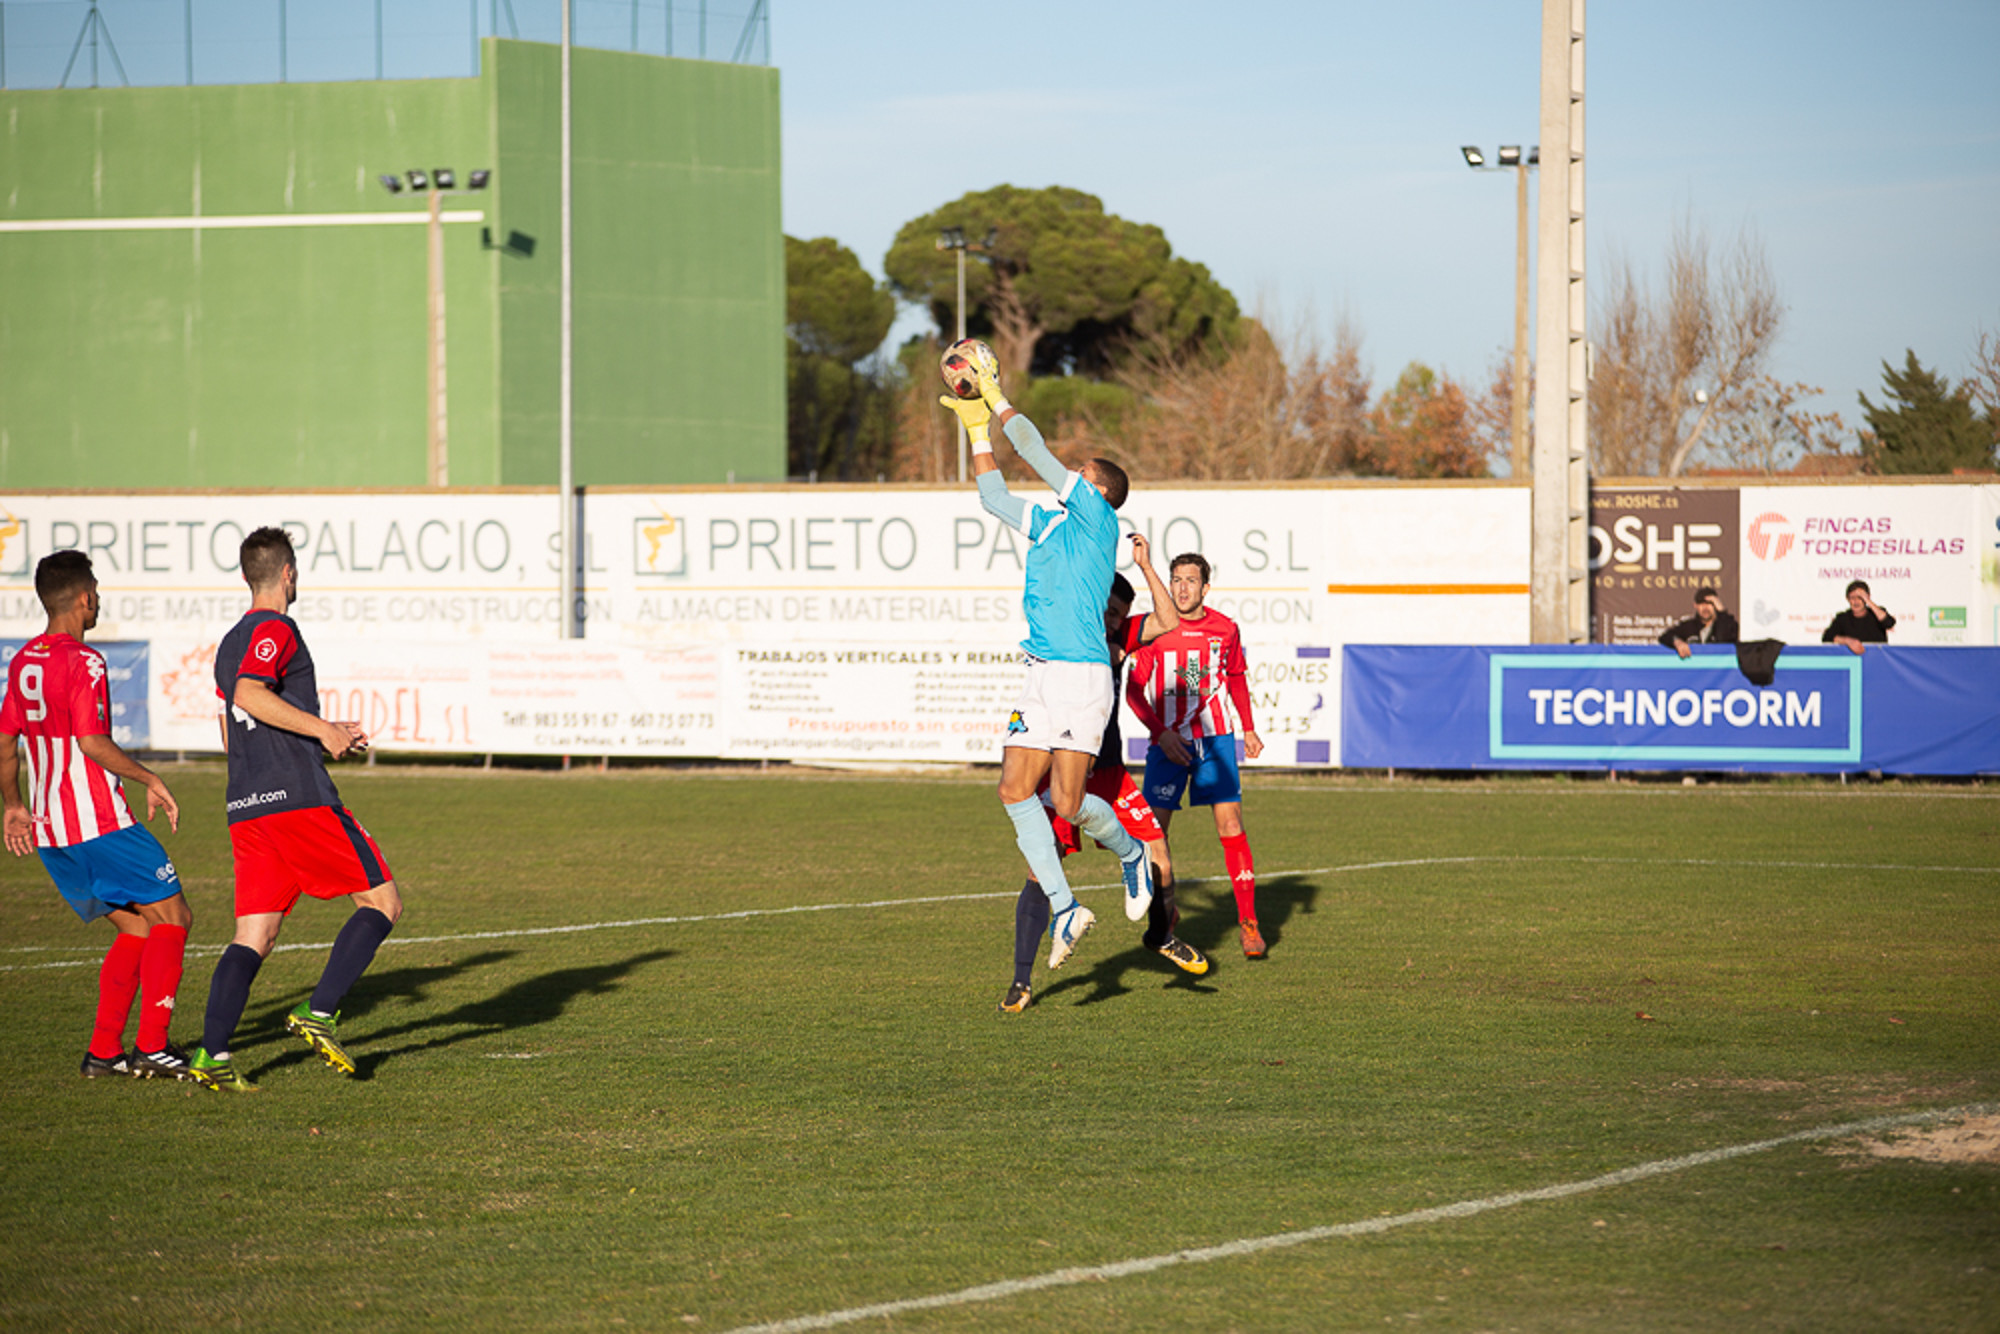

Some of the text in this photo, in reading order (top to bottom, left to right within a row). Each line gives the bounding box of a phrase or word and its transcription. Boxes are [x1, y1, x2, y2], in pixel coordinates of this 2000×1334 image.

[1804, 517, 1892, 534] FINCAS
[51, 519, 245, 574] PRIETO
[709, 516, 1310, 582] PRIETO PAIO, S.L
[1802, 537, 1965, 555] TORDESILLAS
[1643, 576, 1722, 588] COCINAS
[1818, 567, 1912, 580] INMOBILIARIA
[119, 596, 156, 621] DE
[164, 596, 333, 622] MATERES
[341, 596, 378, 621] DE
[387, 596, 613, 622] CONSTRUCCON
[637, 597, 773, 622] ALMACEN
[782, 597, 820, 622] DE
[830, 597, 1011, 622] MATERIALES
[738, 651, 828, 663] TRABAJOS
[834, 651, 943, 664] VERTICALES
[950, 651, 960, 664] Y
[19, 664, 47, 722] 9
[1529, 688, 1822, 727] TECHNOFORM
[562, 712, 579, 728] 55
[788, 717, 910, 733] Presupuesto
[915, 719, 945, 731] sin
[1264, 716, 1311, 734] 113
[965, 738, 993, 750] 692
